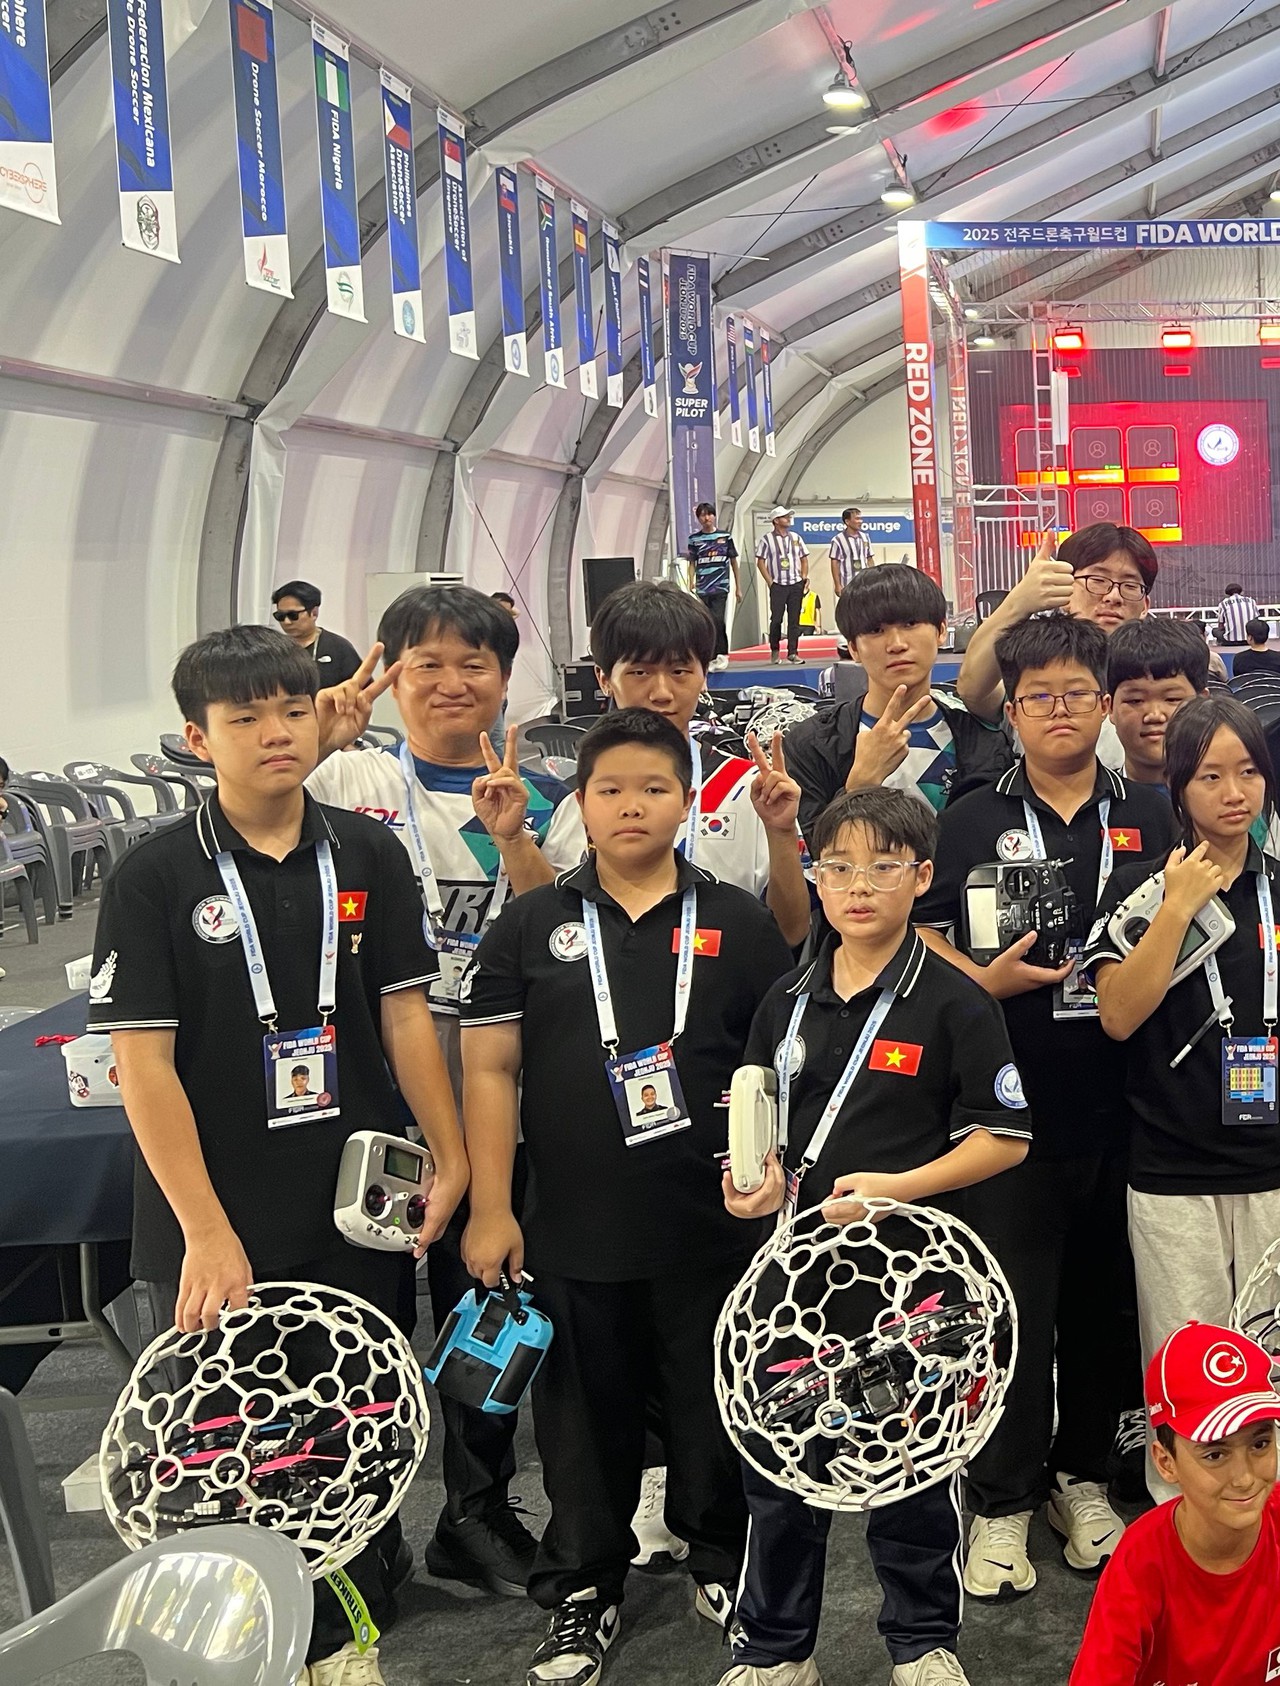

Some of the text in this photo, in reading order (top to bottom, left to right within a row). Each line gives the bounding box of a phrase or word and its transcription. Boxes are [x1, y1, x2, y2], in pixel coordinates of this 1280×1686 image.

[127, 17, 137, 66] Drone
[130, 69, 139, 125] Soccer
[142, 91, 155, 168] Mexicana
[251, 61, 266, 222] Drone Soccer Morocco
[330, 109, 343, 190] FIDA Nigeria
[390, 144, 398, 215] Association
[963, 226, 1127, 242] 2025 전주드론축구월드컵
[1136, 224, 1196, 244] FIDA
[906, 342, 930, 401] RED
[675, 397, 708, 408] SUPER
[909, 407, 935, 486] ZONE
[803, 521, 901, 533] Refere ounge
